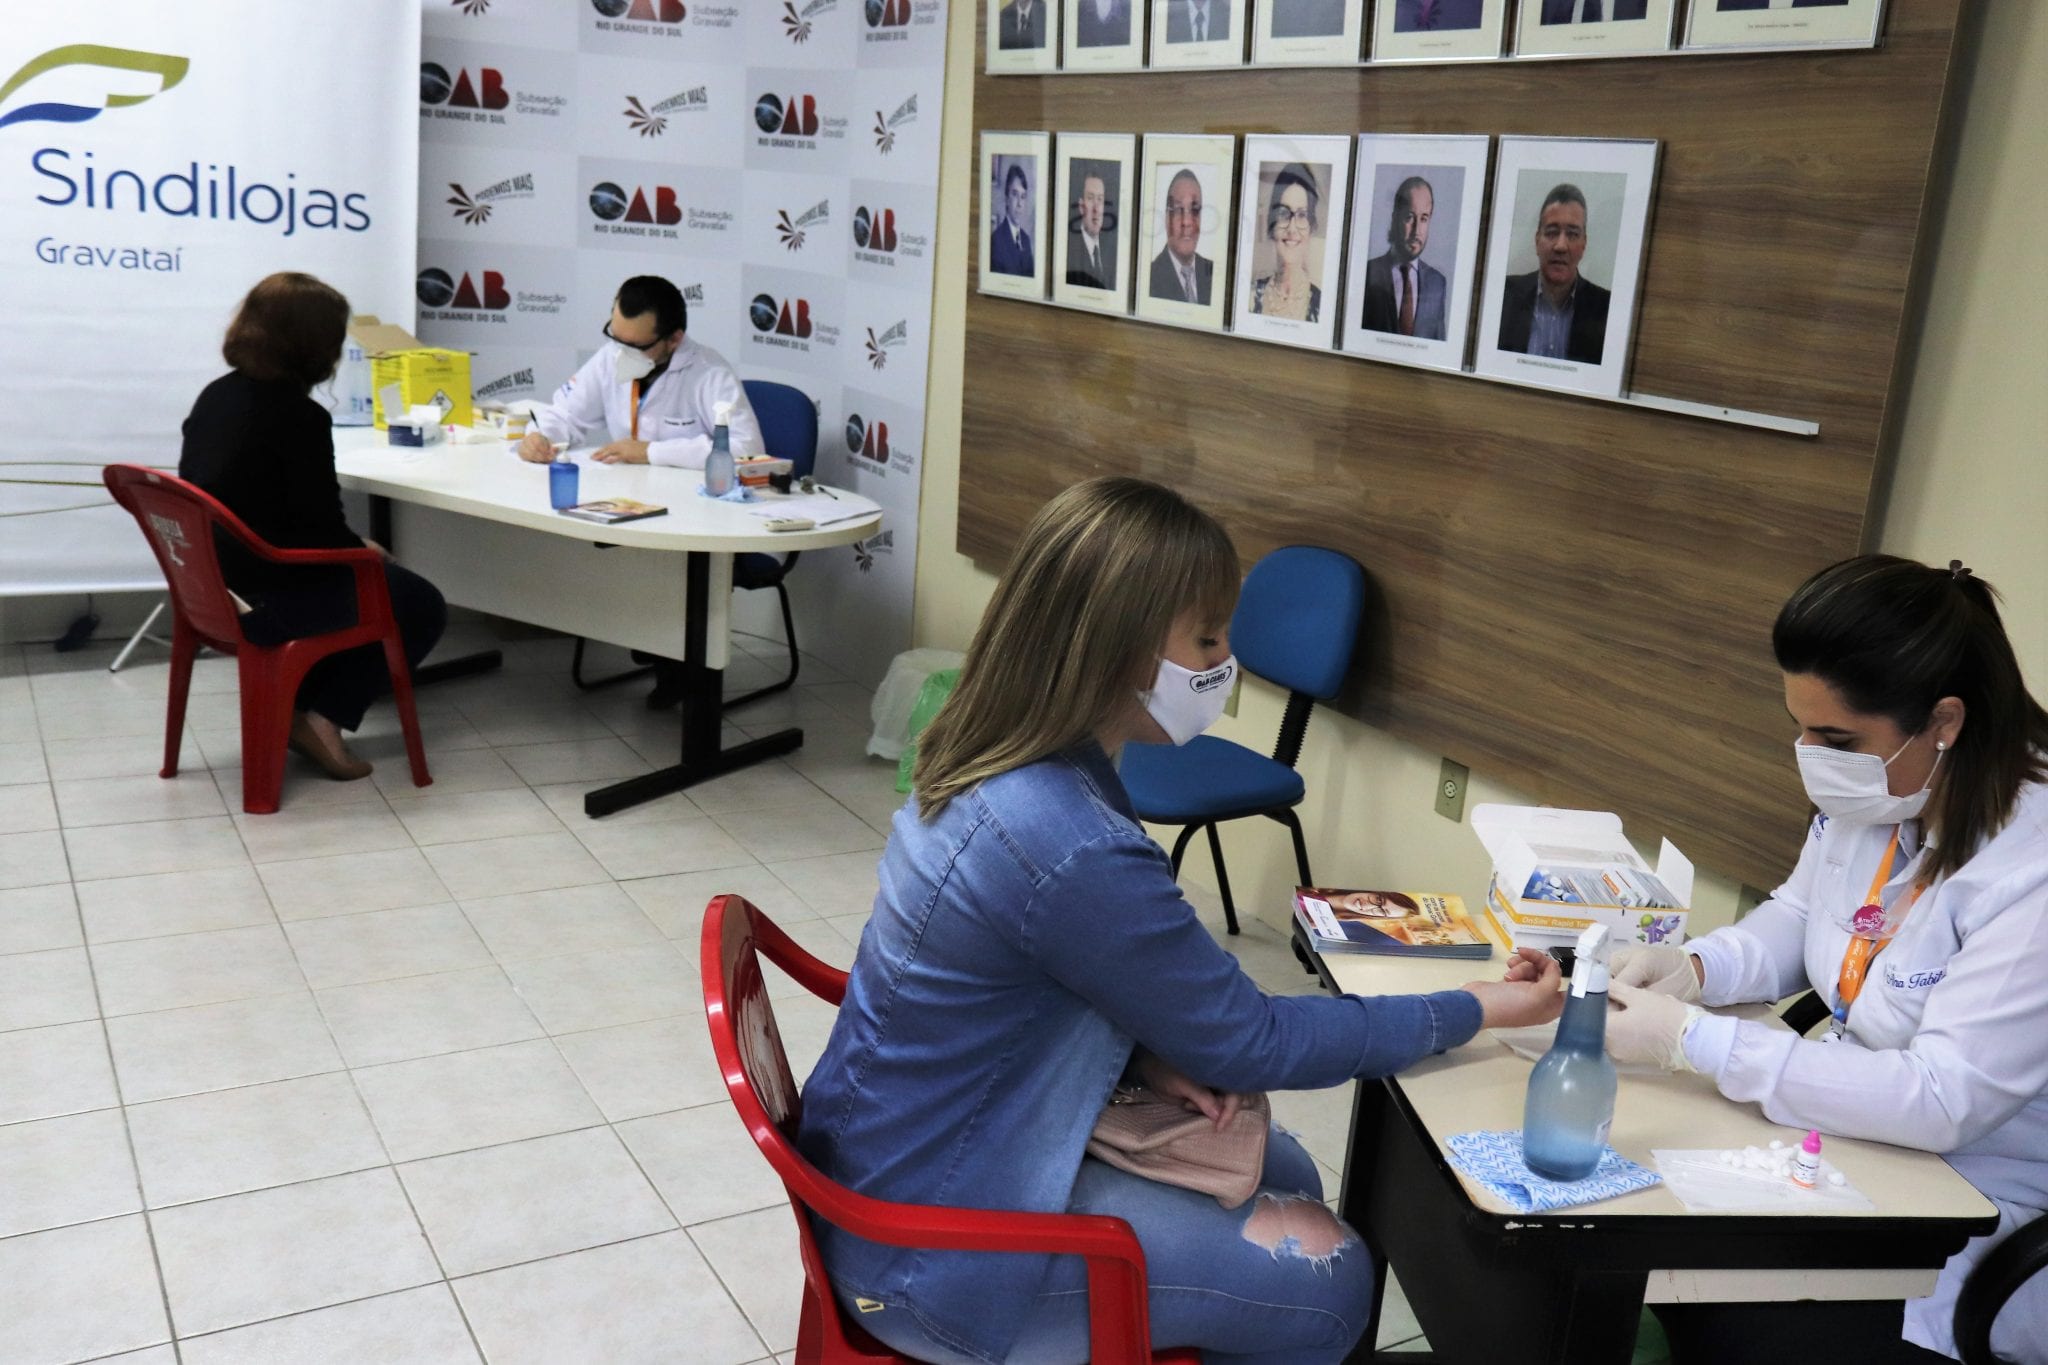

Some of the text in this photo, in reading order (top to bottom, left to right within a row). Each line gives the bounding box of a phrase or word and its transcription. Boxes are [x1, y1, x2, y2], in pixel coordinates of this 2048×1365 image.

[420, 62, 509, 110] OAB
[754, 93, 819, 136] OAB
[31, 147, 372, 236] Sindilojas
[589, 182, 683, 226] OAB
[594, 224, 609, 233] RIO
[610, 225, 645, 236] GRANDE
[853, 205, 898, 253] OAB
[36, 236, 183, 272] Gravataí
[416, 268, 511, 310] OAB
[750, 293, 812, 339] OAB
[513, 368, 534, 386] MAIS
[846, 413, 889, 464] OAB
[1908, 970, 1946, 989] Tabit
